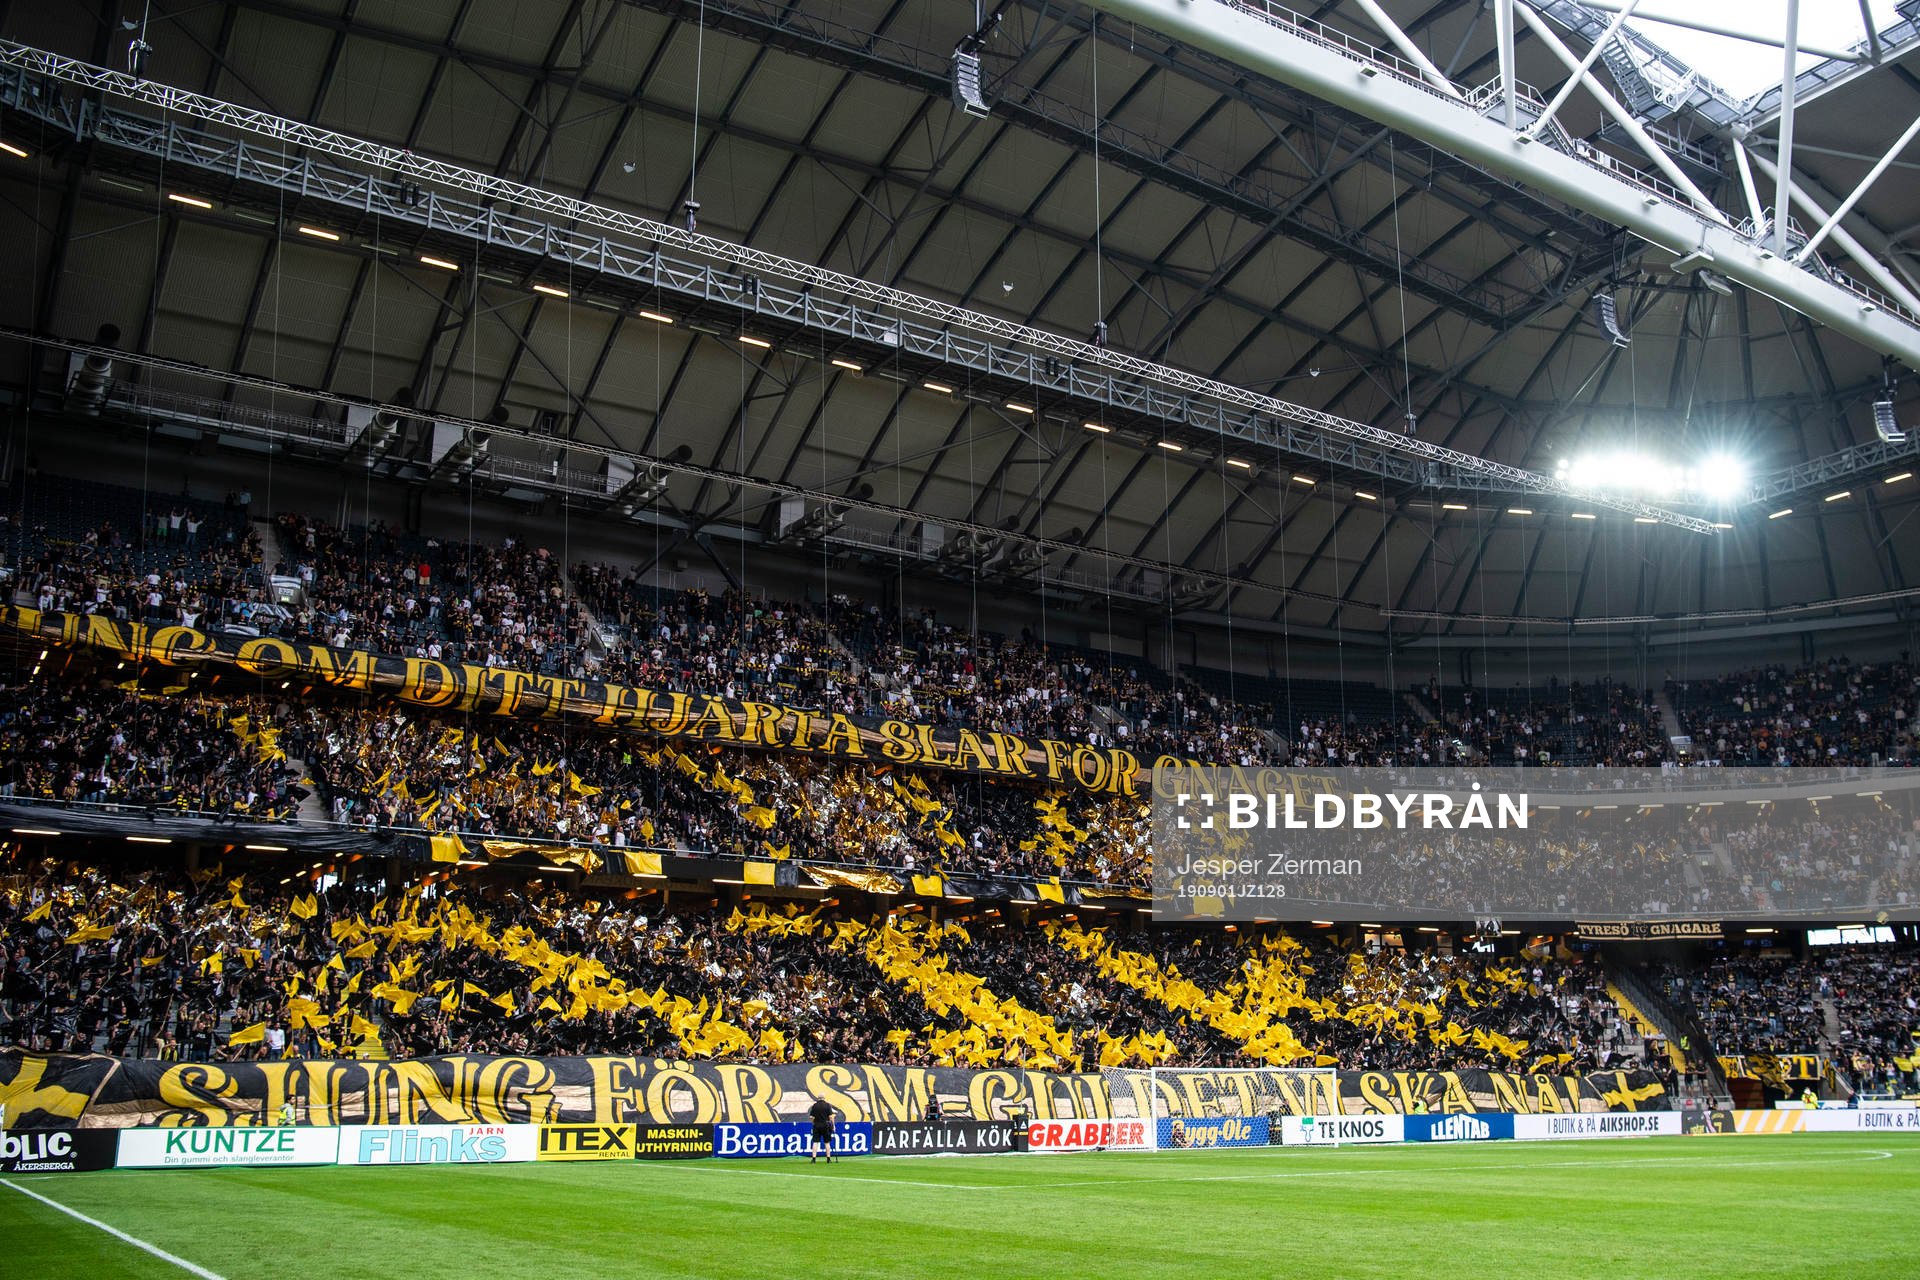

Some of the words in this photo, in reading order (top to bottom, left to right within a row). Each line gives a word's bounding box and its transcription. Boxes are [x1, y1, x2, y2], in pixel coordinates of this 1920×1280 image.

[235, 637, 378, 692] OM
[396, 657, 585, 718] DITT
[593, 683, 868, 758] HJÄRTA
[879, 720, 1037, 777] SLÅR
[1039, 738, 1141, 798] FÖR
[1152, 754, 1341, 812] GNAGET
[1578, 922, 1629, 936] TYRESÖ
[1650, 923, 1721, 935] GNAGARE
[159, 1057, 563, 1126] SJUNG
[586, 1057, 783, 1124] FÖR
[1273, 1073, 1346, 1116] VI
[1360, 1072, 1479, 1114] SKA
[1318, 1120, 1384, 1139] TEKNOS
[1431, 1114, 1490, 1140] LLENTAB
[1553, 1118, 1575, 1133] BUTIK
[1578, 1119, 1584, 1133] &
[1586, 1114, 1596, 1132] PÅ
[1599, 1116, 1659, 1132] AIKSHOP.SE
[1865, 1112, 1893, 1127] BUTIK
[1896, 1113, 1903, 1127] &
[1908, 1109, 1920, 1127] PÅ
[165, 1129, 296, 1153] KUNTZE
[358, 1129, 507, 1163] Flinks
[541, 1127, 628, 1151] ITEX
[647, 1129, 703, 1139] MASKIN-
[874, 1127, 967, 1149] JÄRFÄLLA
[977, 1125, 1013, 1147] KÖK
[1028, 1123, 1145, 1147] GRABBER
[636, 1142, 713, 1153] UTHYRNING
[14, 1161, 75, 1171] ÅKERSBERGA
